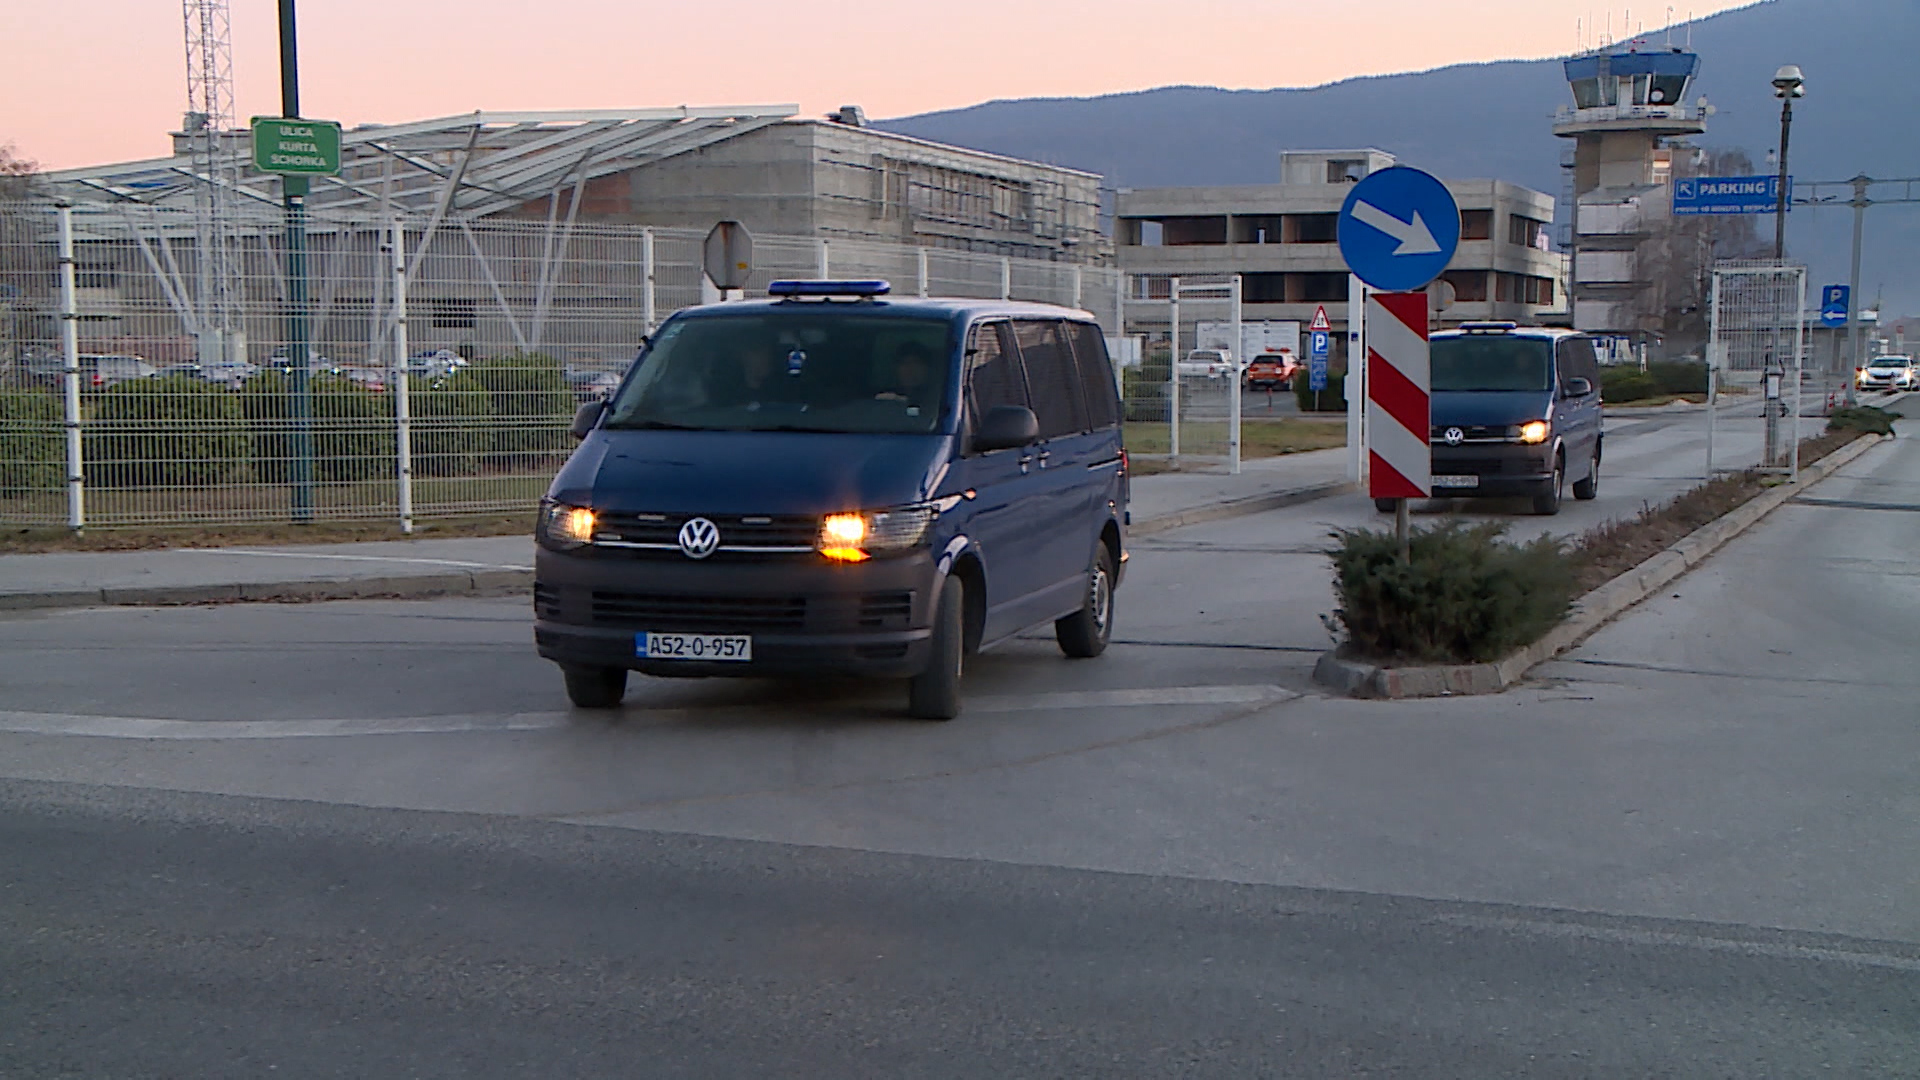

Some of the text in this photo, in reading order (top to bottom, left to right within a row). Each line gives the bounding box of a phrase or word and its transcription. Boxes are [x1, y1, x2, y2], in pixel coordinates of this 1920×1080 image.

[280, 125, 314, 137] ULICA
[279, 141, 318, 152] KURTA
[270, 153, 327, 166] SCHORKA
[1700, 181, 1766, 195] PARKING
[1830, 288, 1842, 302] P
[1315, 335, 1325, 352] P
